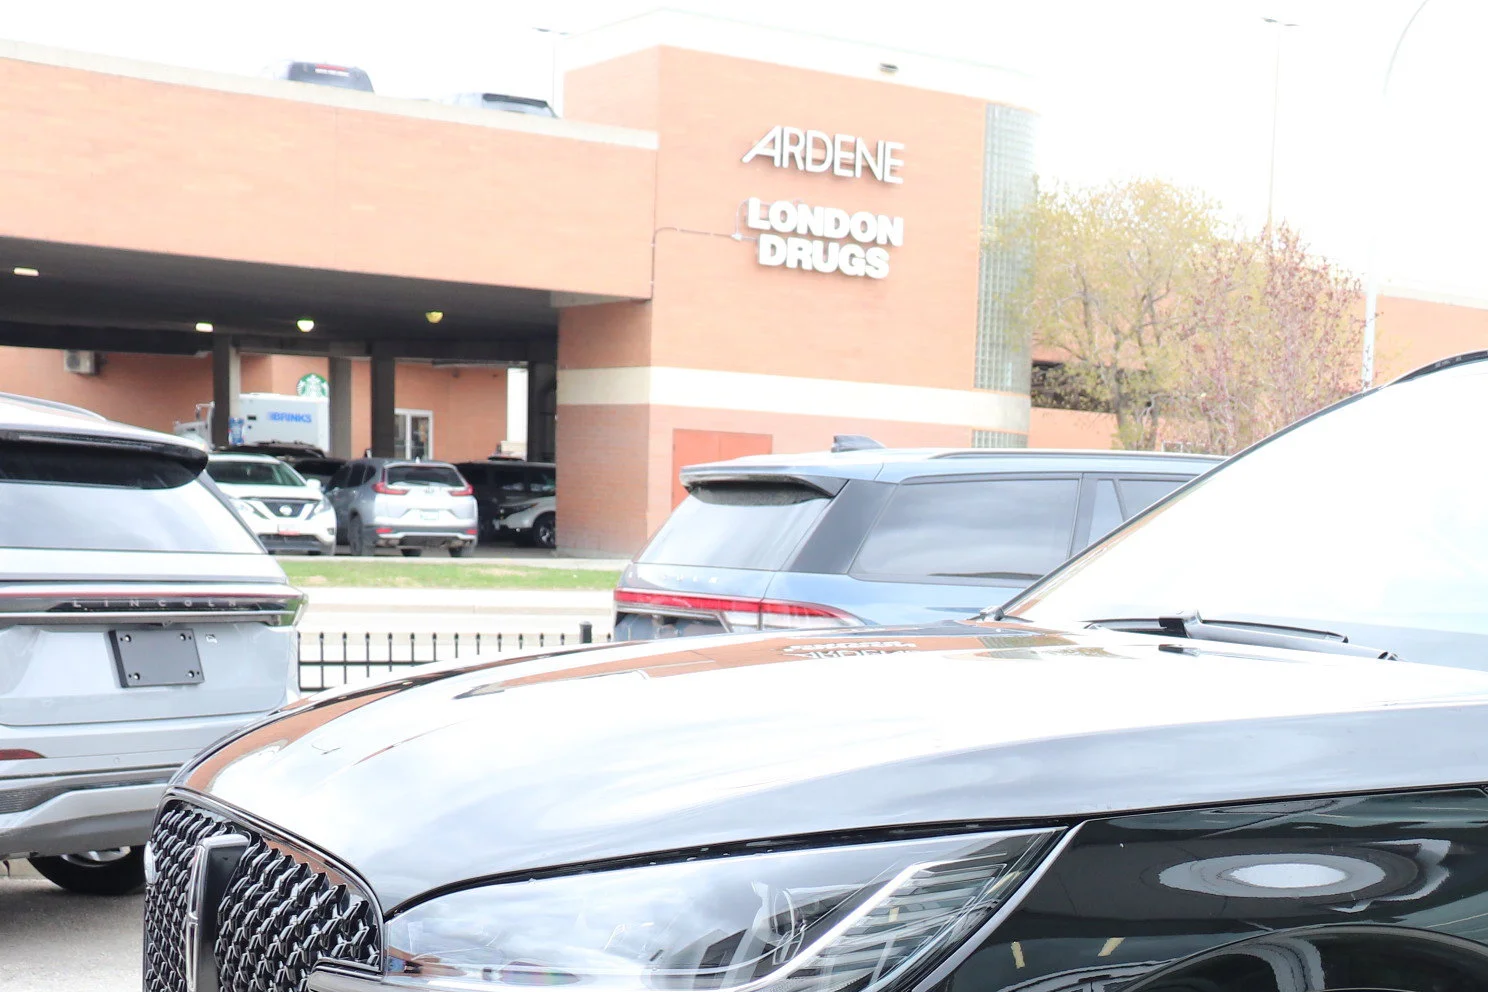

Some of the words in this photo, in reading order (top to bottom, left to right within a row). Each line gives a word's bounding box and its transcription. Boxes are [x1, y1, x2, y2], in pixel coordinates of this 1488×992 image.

[741, 125, 905, 184] ARDENE
[747, 197, 904, 246] LONDON
[758, 233, 890, 279] DRUGS
[72, 599, 237, 609] LINCOLN
